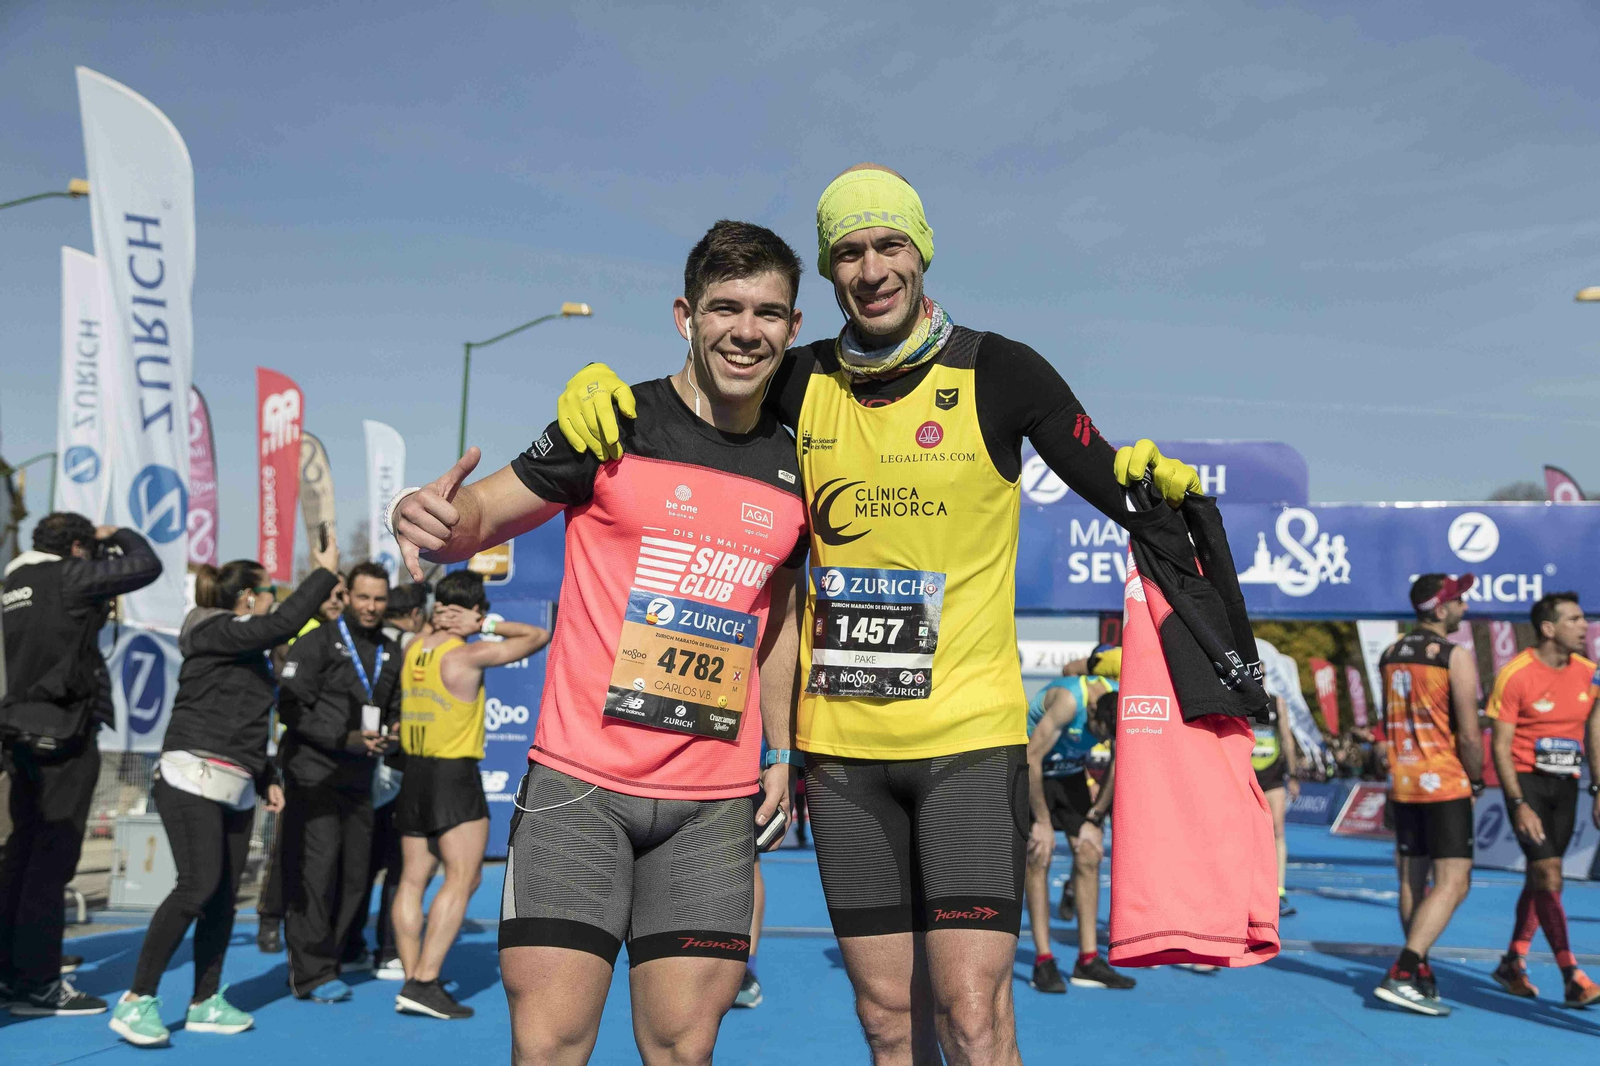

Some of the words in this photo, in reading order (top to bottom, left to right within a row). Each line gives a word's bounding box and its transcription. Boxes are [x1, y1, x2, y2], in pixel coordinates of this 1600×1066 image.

[880, 452, 976, 464] LEGALITAS.COM
[855, 486, 919, 501] CLÍNICA
[665, 500, 678, 510] be
[680, 504, 698, 513] one
[855, 501, 948, 518] MENORCA
[746, 508, 770, 524] AGA
[673, 528, 694, 539] DIS
[700, 534, 712, 542] IS
[716, 538, 737, 549] MAI
[742, 544, 761, 555] TIM
[690, 547, 774, 590] SIRIUS
[679, 574, 735, 602] CLUB
[849, 577, 925, 596] ZURICH
[678, 610, 745, 636] ZURICH
[836, 615, 904, 645] 1457
[675, 636, 698, 645] MARATÓN
[657, 647, 724, 684] 4782
[855, 654, 876, 664] PAKE
[654, 680, 696, 697] CARLOS
[699, 689, 713, 700] V.B.
[886, 686, 925, 696] ZURICH
[625, 708, 645, 717] balance
[1127, 701, 1162, 715] AGA
[663, 717, 693, 728] ZURICH
[709, 713, 737, 725] Cruzcampo
[1126, 727, 1163, 735] aga.cloud
